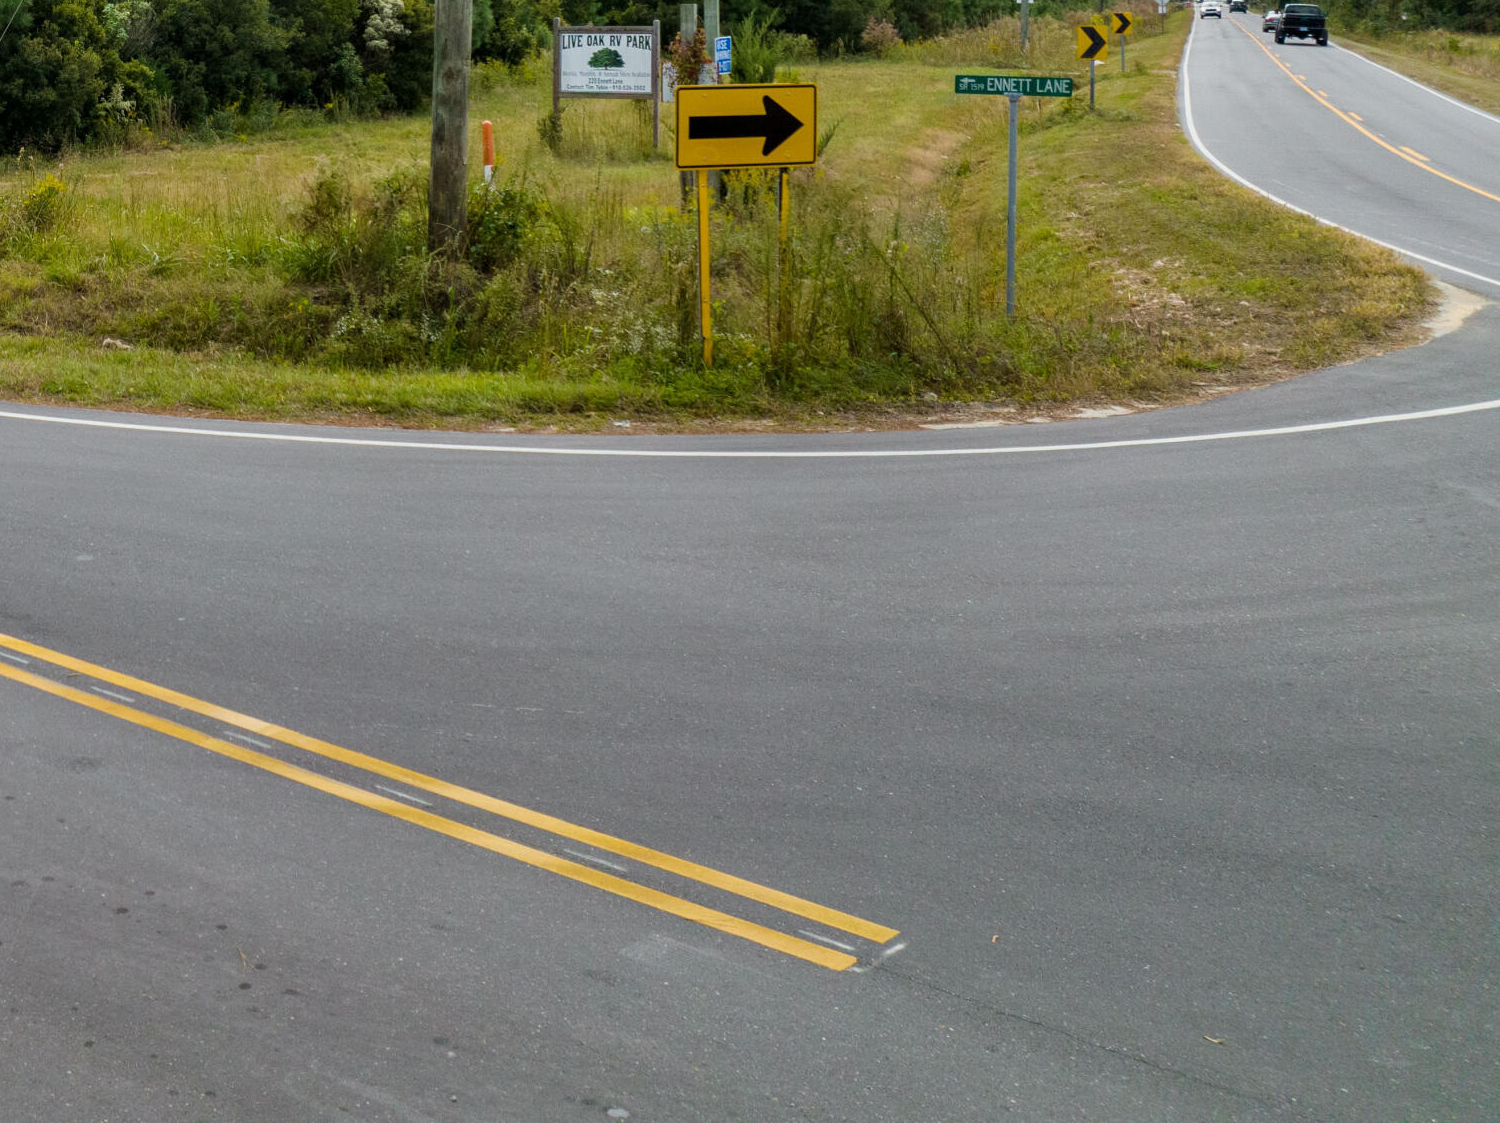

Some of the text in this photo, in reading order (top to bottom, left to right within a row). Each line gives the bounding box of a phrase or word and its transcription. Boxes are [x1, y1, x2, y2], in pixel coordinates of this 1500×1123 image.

[562, 35, 652, 50] LIVE OAK RV PARK
[987, 77, 1071, 93] ENNETT LANE
